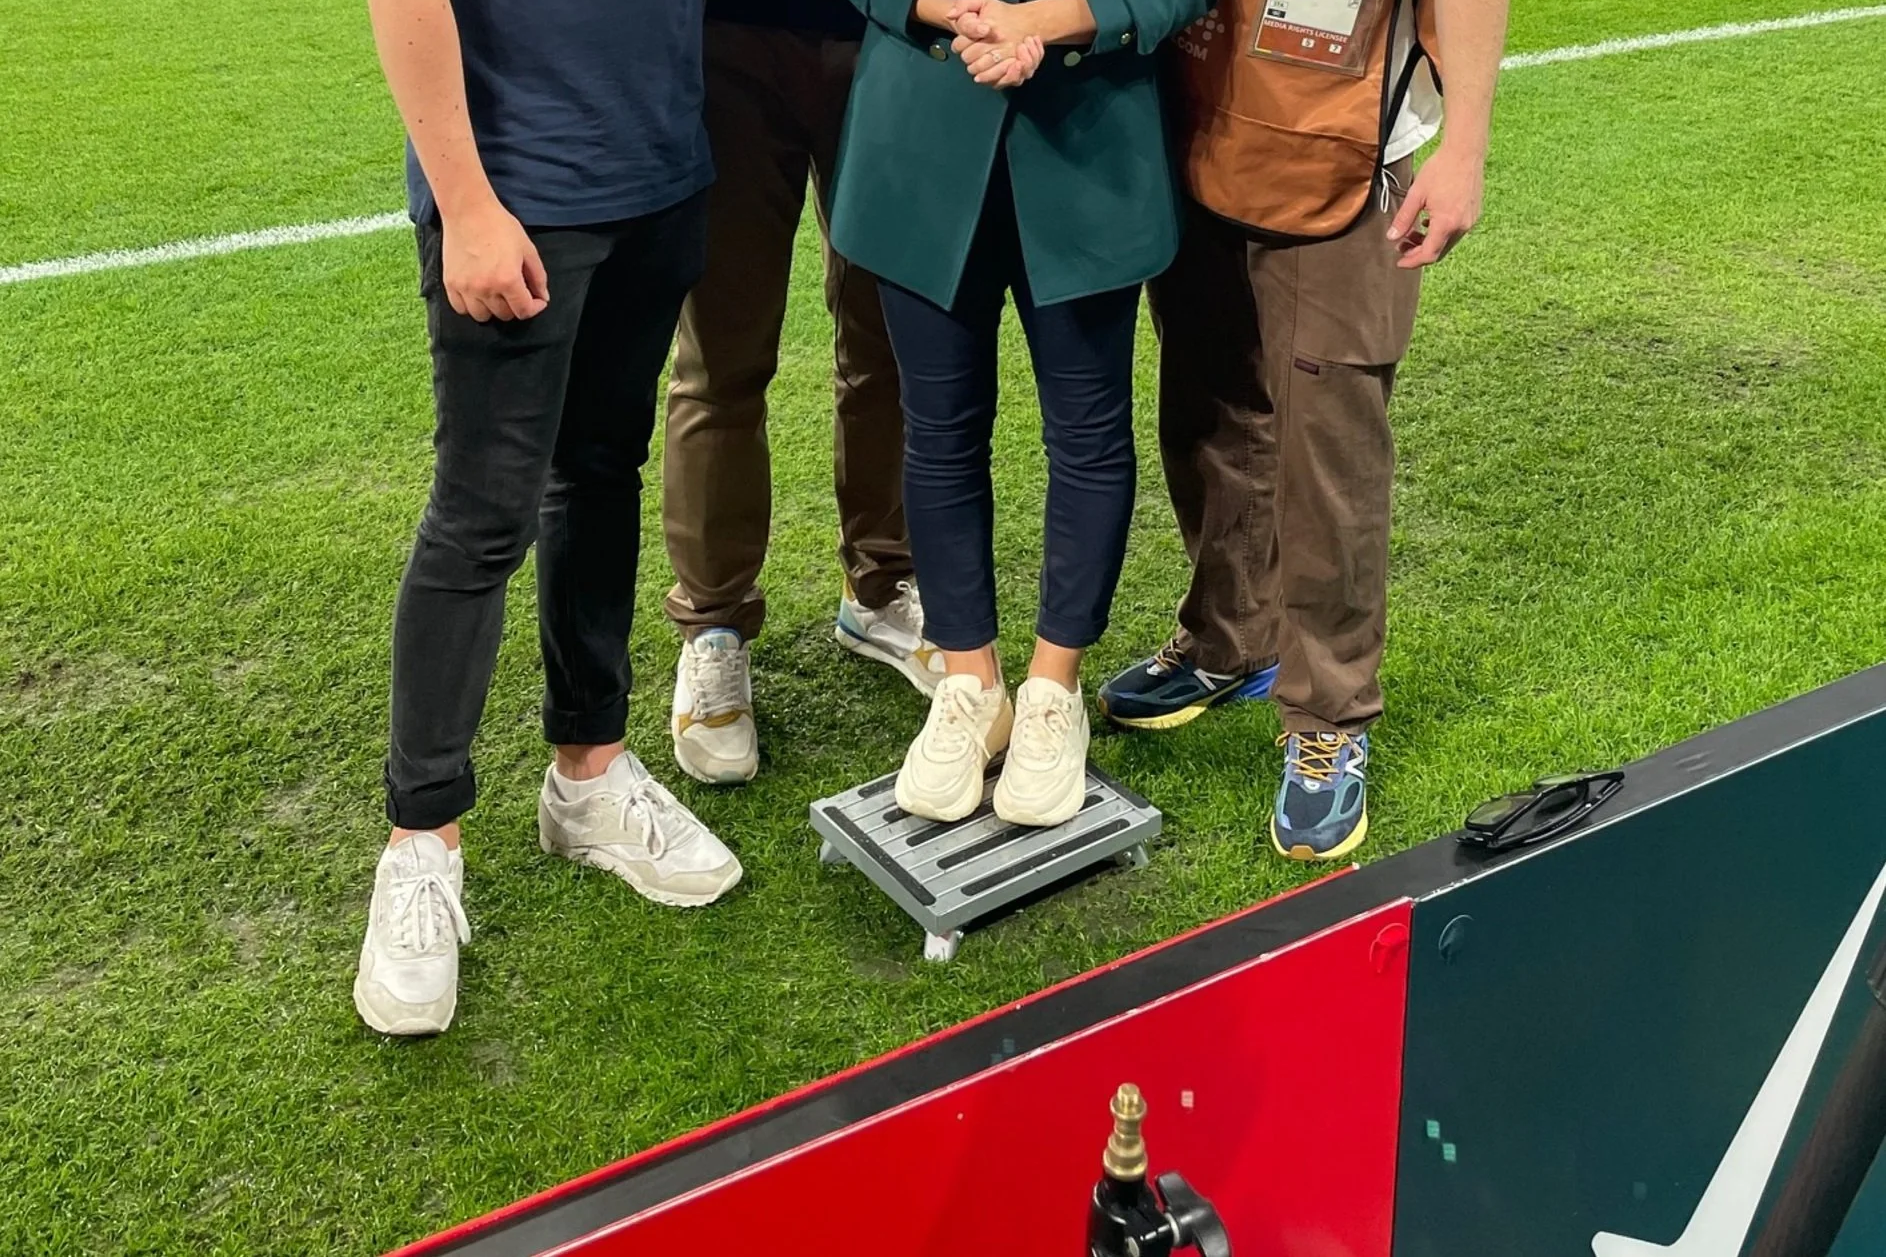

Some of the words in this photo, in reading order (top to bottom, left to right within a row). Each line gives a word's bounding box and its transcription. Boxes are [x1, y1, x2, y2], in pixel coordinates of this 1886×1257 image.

[1264, 19, 1287, 31] MEDIA
[1287, 24, 1314, 37] RIGHTS
[1314, 30, 1349, 44] LICENSEE
